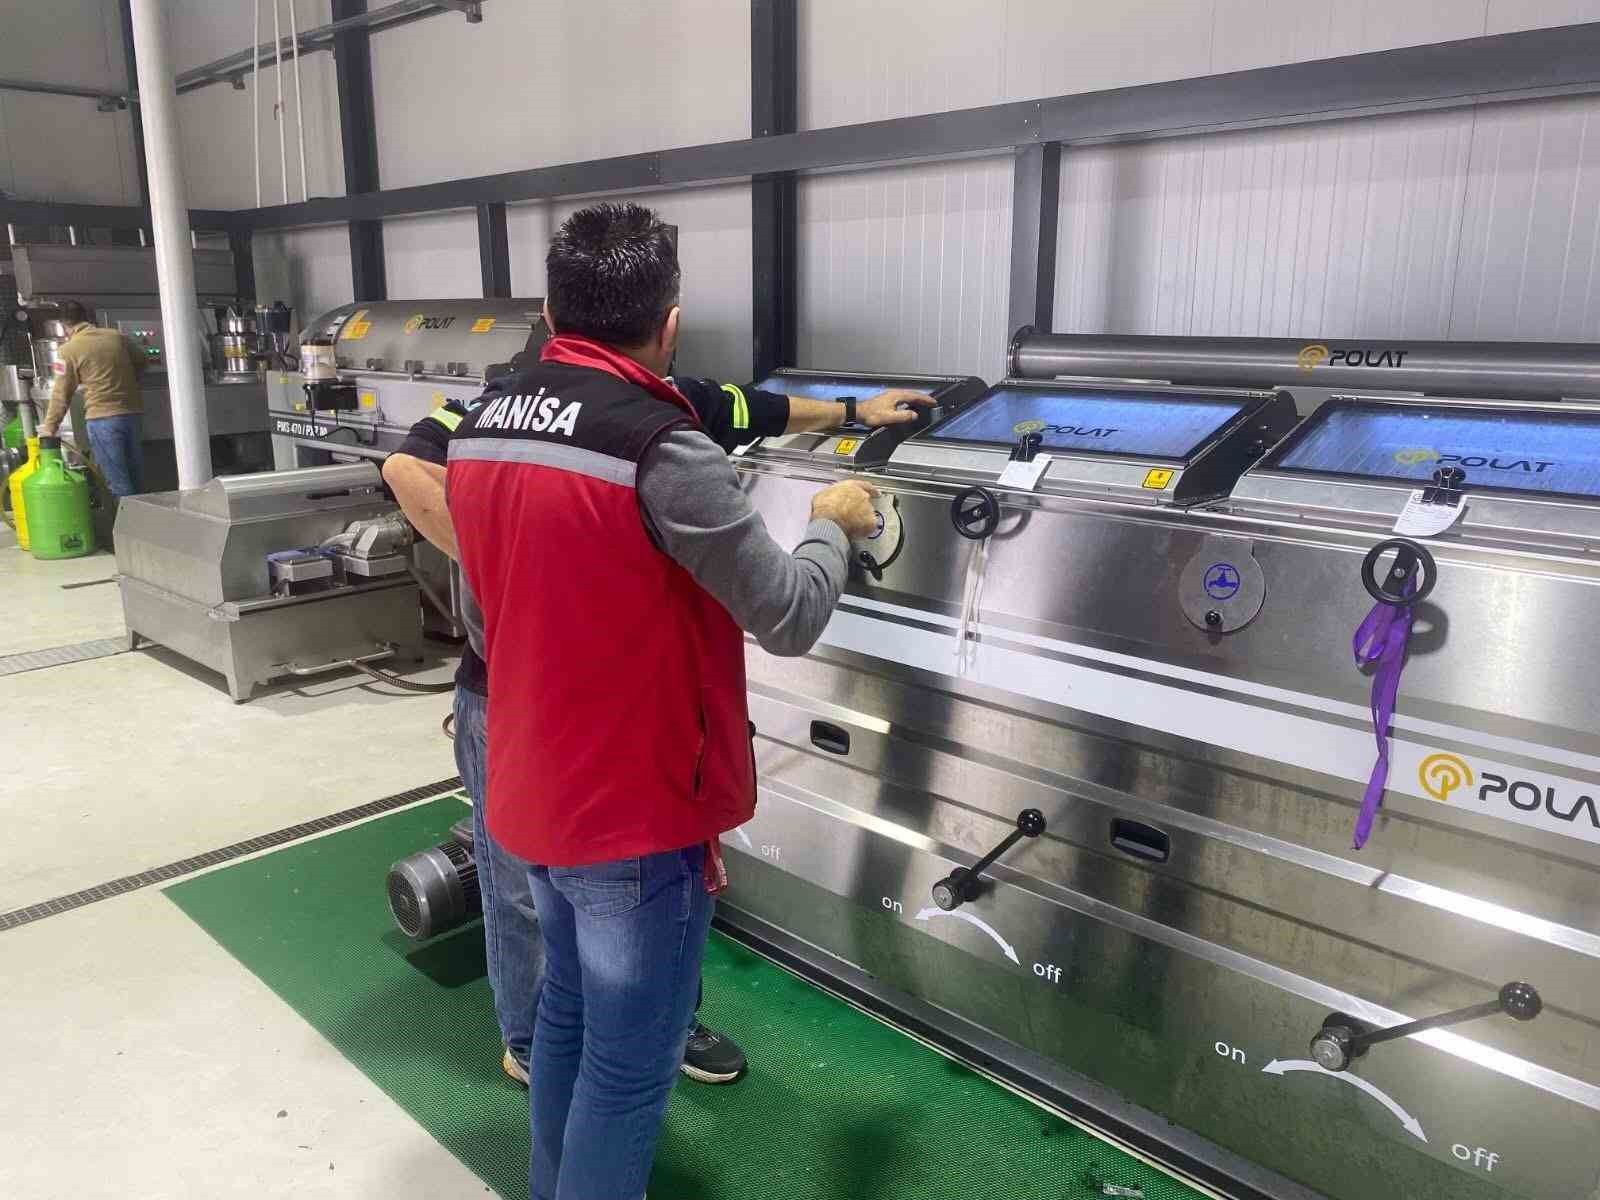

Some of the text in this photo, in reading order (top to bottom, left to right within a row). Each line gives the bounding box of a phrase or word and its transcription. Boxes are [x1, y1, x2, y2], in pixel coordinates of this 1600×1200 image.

[1329, 350, 1409, 368] POLAT
[474, 387, 583, 437] MANİSA
[1039, 424, 1120, 438] POLAT
[1435, 454, 1556, 473] POLAT
[760, 844, 782, 861] off
[881, 896, 904, 914] on
[1032, 962, 1063, 984] off
[1213, 1038, 1247, 1065] on
[1451, 1142, 1502, 1173] off
